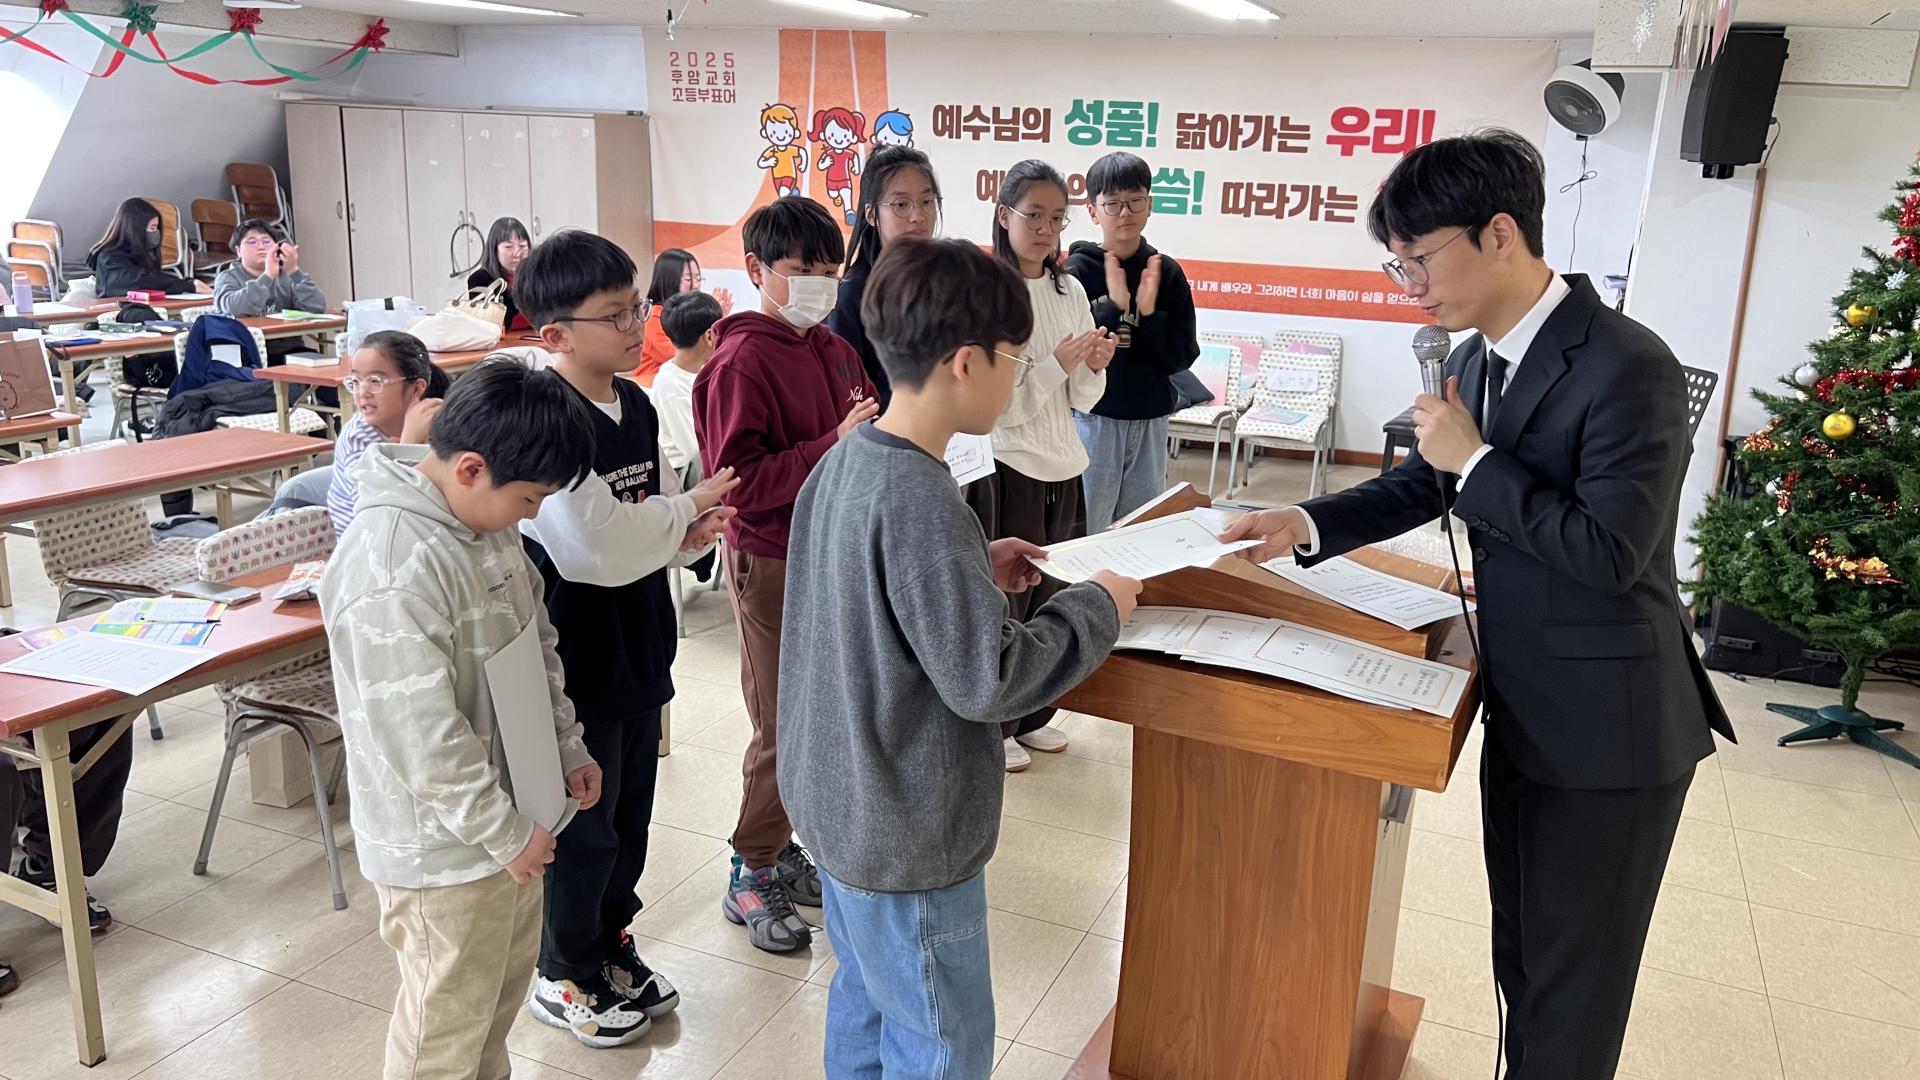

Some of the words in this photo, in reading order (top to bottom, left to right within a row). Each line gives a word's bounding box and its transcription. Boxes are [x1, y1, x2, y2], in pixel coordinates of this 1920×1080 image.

[669, 51, 735, 68] 2025
[671, 69, 736, 86] 후암교회
[672, 86, 736, 104] 초등부표어
[932, 104, 1051, 143] 예수님의
[1064, 98, 1159, 147] 성품!
[1176, 112, 1311, 153] 닮아가는
[1151, 167, 1205, 215] 씀!
[1220, 181, 1358, 223] 따라가는
[1197, 280, 1218, 292] 내게
[1220, 282, 1252, 295] 배우라
[1255, 283, 1298, 298] 그리하면
[1300, 287, 1322, 300] 너희
[1325, 288, 1358, 302] 마음이
